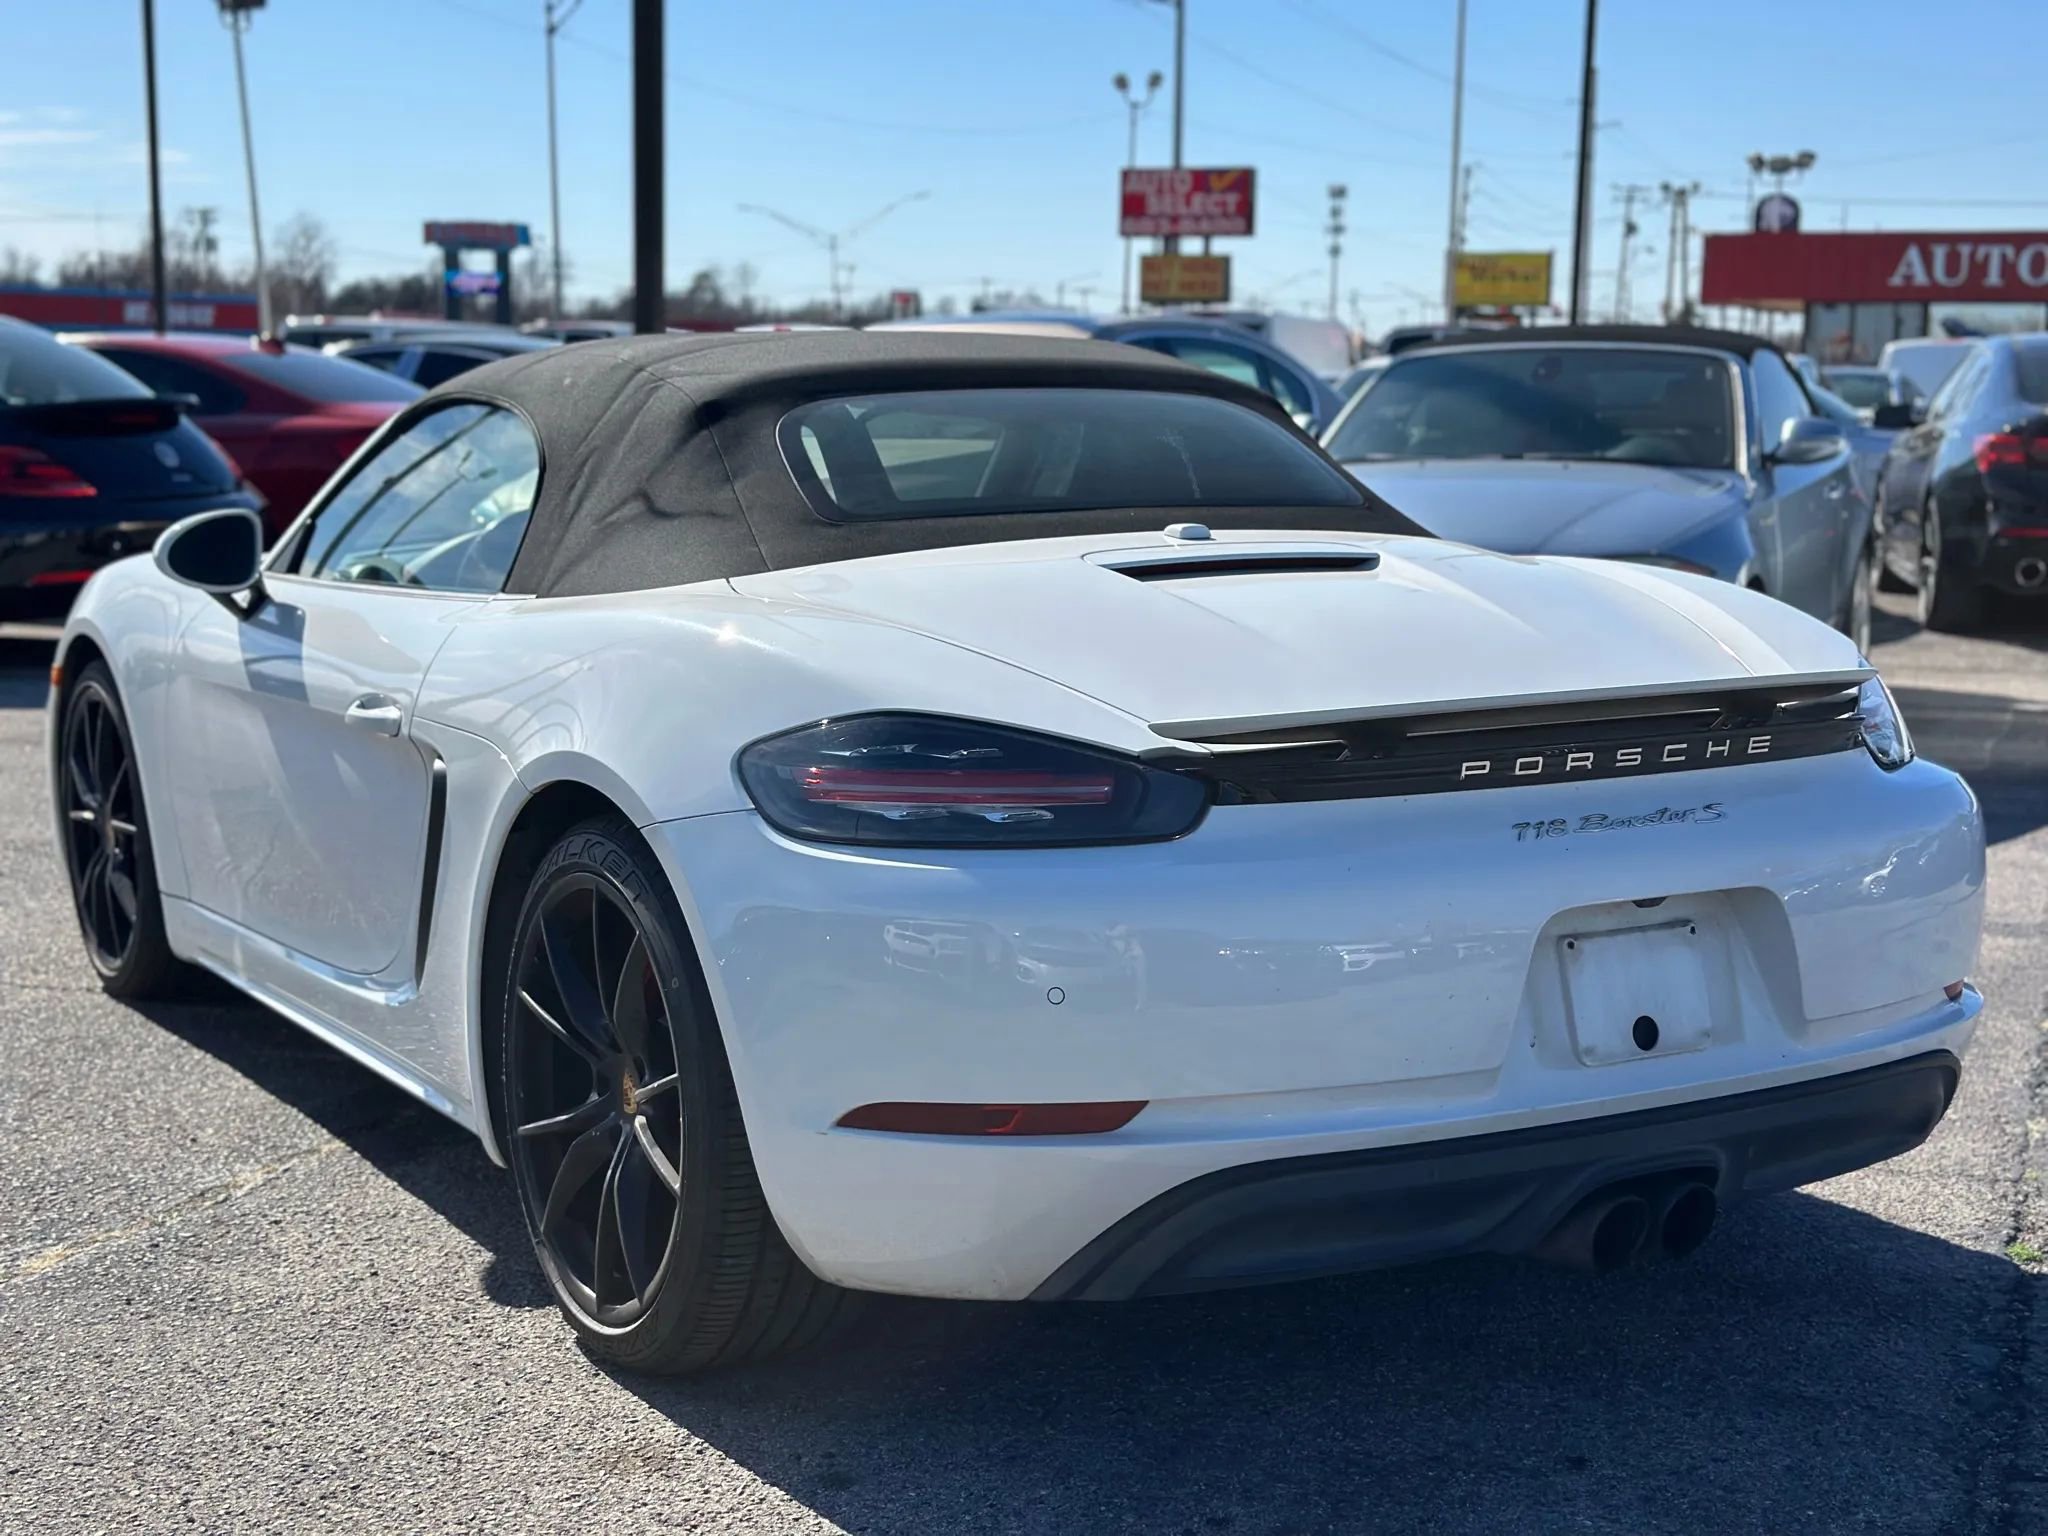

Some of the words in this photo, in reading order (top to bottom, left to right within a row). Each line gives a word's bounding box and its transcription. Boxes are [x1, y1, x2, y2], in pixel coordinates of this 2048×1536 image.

[1887, 242, 2048, 287] AUTO
[1459, 736, 1772, 781] PORSCHE
[1512, 818, 1569, 842] 718
[1573, 807, 1696, 833] Boxster
[1695, 802, 1728, 825] S
